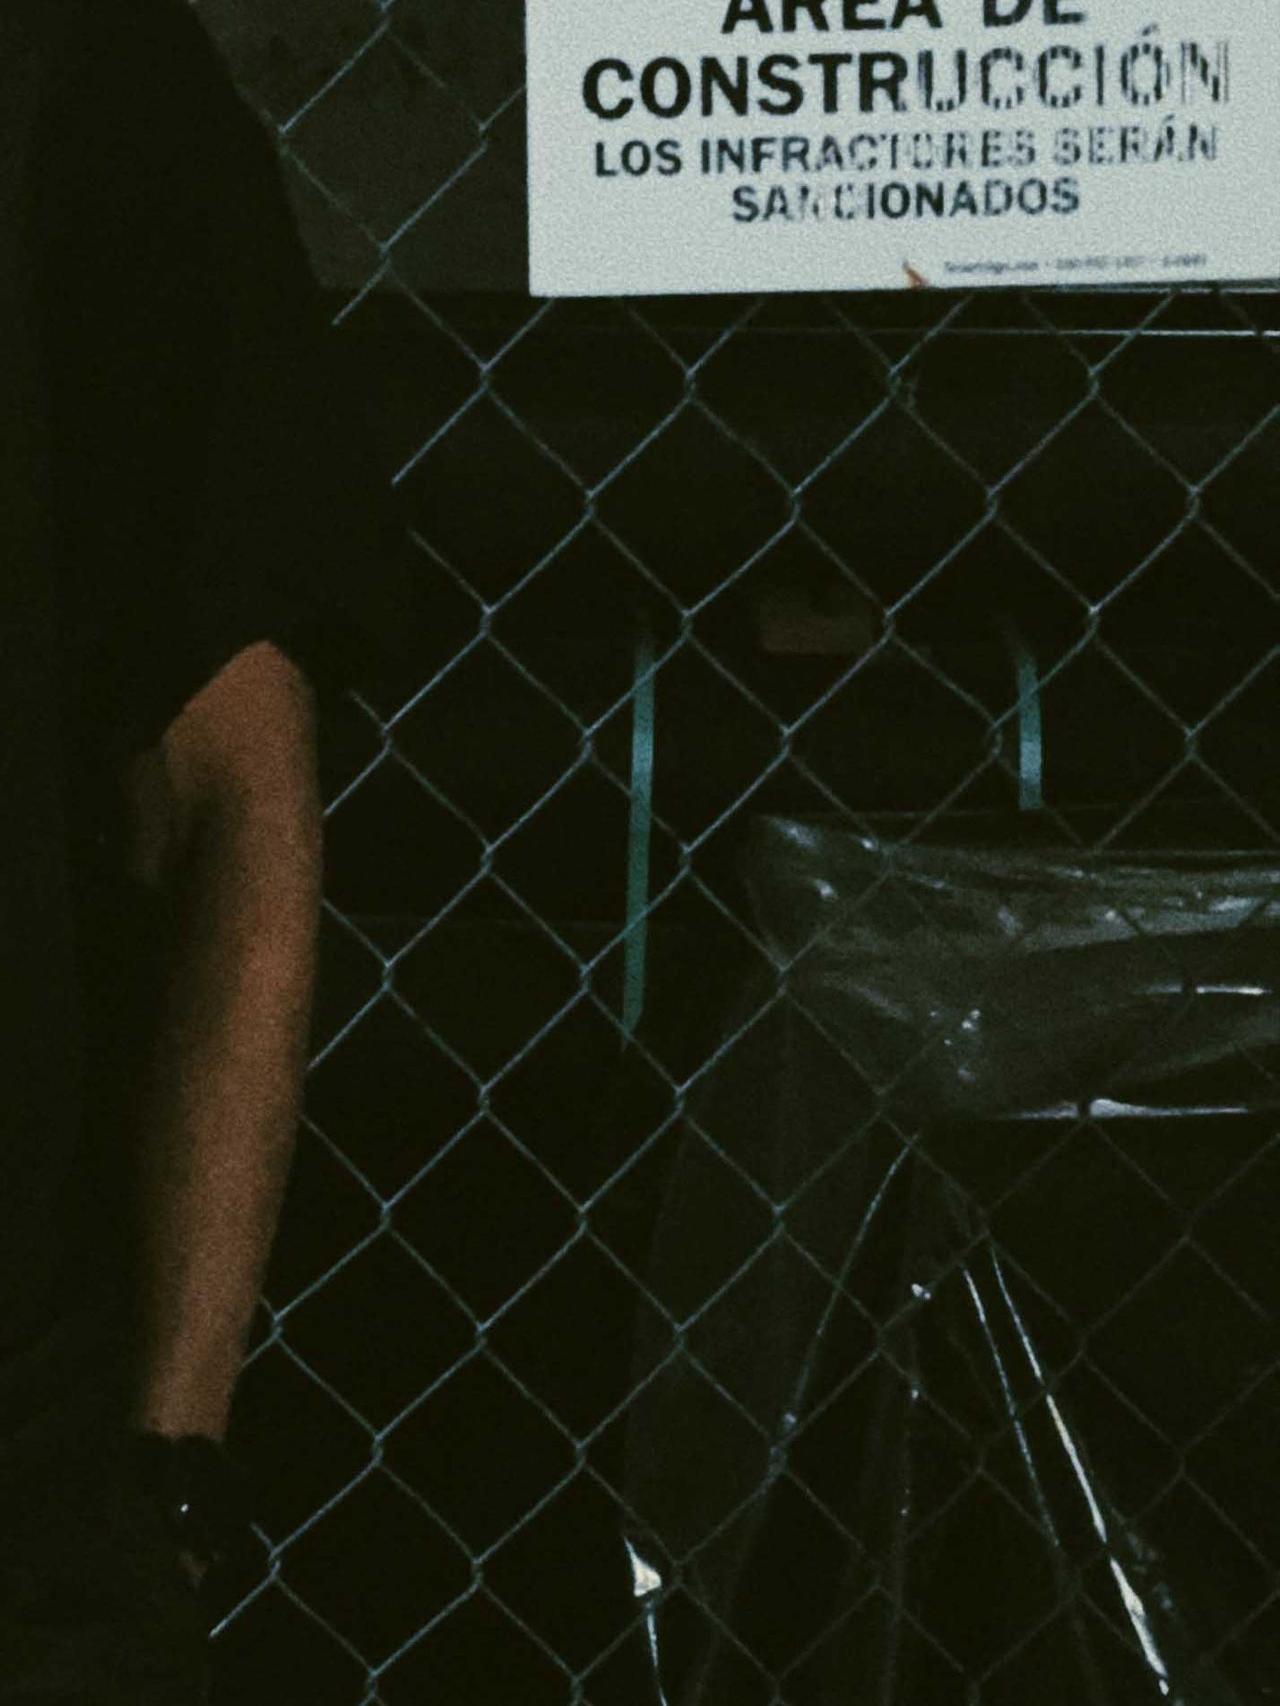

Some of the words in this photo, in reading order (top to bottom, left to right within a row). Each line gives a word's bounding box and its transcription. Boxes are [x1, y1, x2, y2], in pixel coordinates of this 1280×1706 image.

[581, 24, 1229, 120] CONSTRUCCIÓN
[596, 140, 682, 177] LOS
[702, 130, 1036, 174] INFRACTORES
[1052, 115, 1217, 166] SERÁN
[732, 177, 1080, 223] SANCIONADOS
